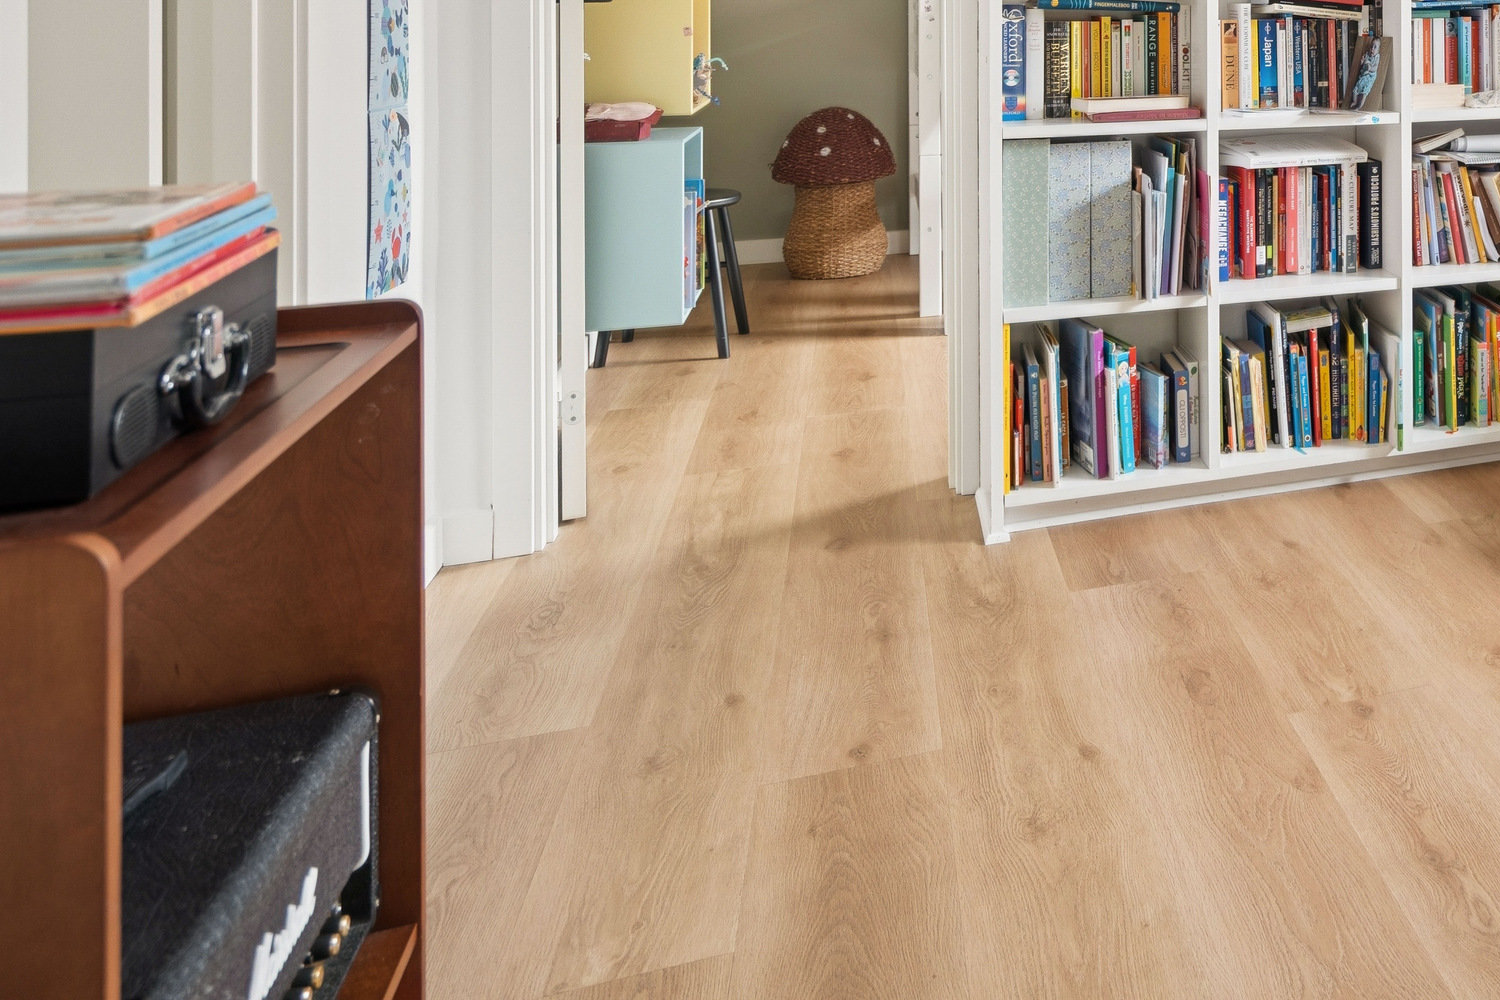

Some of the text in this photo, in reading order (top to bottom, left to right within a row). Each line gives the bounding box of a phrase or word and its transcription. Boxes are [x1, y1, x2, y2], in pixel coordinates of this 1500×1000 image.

[1008, 8, 1025, 63] Oxford
[1148, 19, 1157, 57] RANGE
[1263, 36, 1274, 67] Japan
[1051, 43, 1060, 94] BUFFETT
[1060, 43, 1069, 93] WARREN
[1182, 44, 1190, 82] TOOLKIT
[1225, 55, 1235, 91] DUNE
[1371, 175, 1380, 246] HASHIMOTO'S PROTOCOL
[1456, 175, 1470, 215] ayurvedic
[1219, 199, 1228, 252] MEGACHANGE
[1332, 369, 1340, 408] HISTORIER
